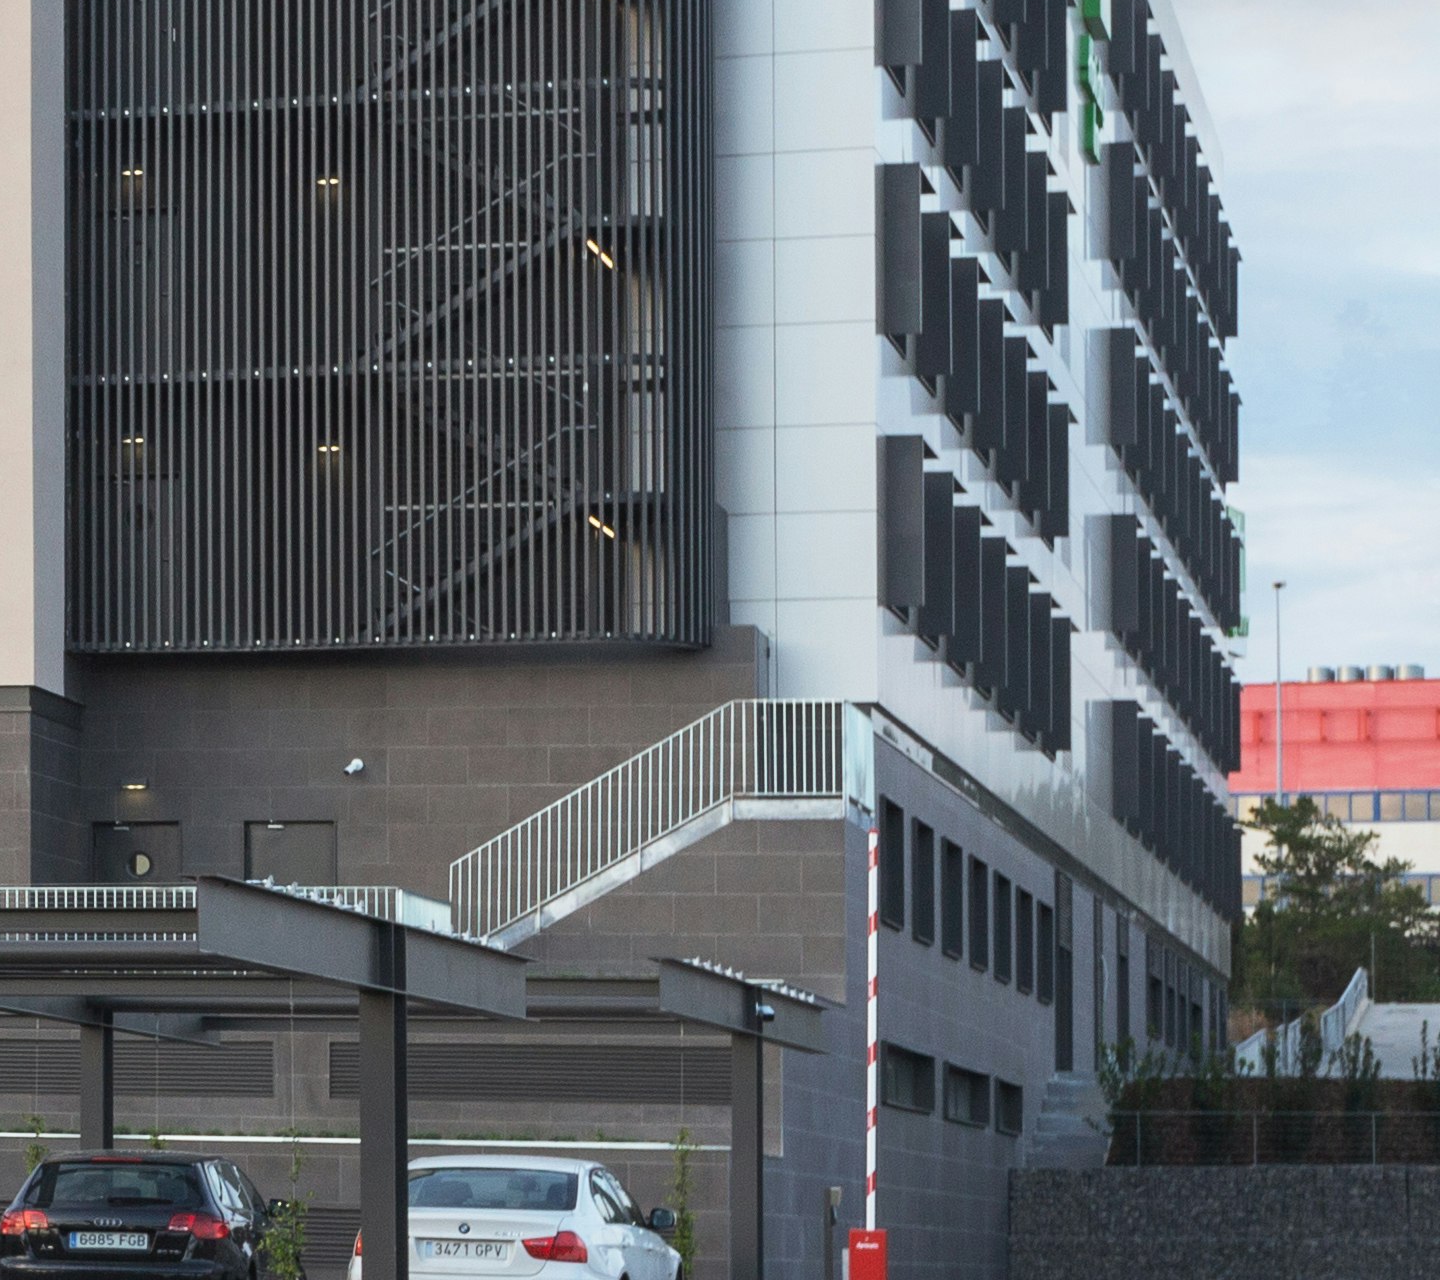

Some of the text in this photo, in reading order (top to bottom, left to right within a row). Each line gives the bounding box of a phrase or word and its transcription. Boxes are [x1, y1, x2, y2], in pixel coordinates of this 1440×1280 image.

[80, 1233, 146, 1247] 6985 FGB
[435, 1242, 503, 1257] 3471 GPV
